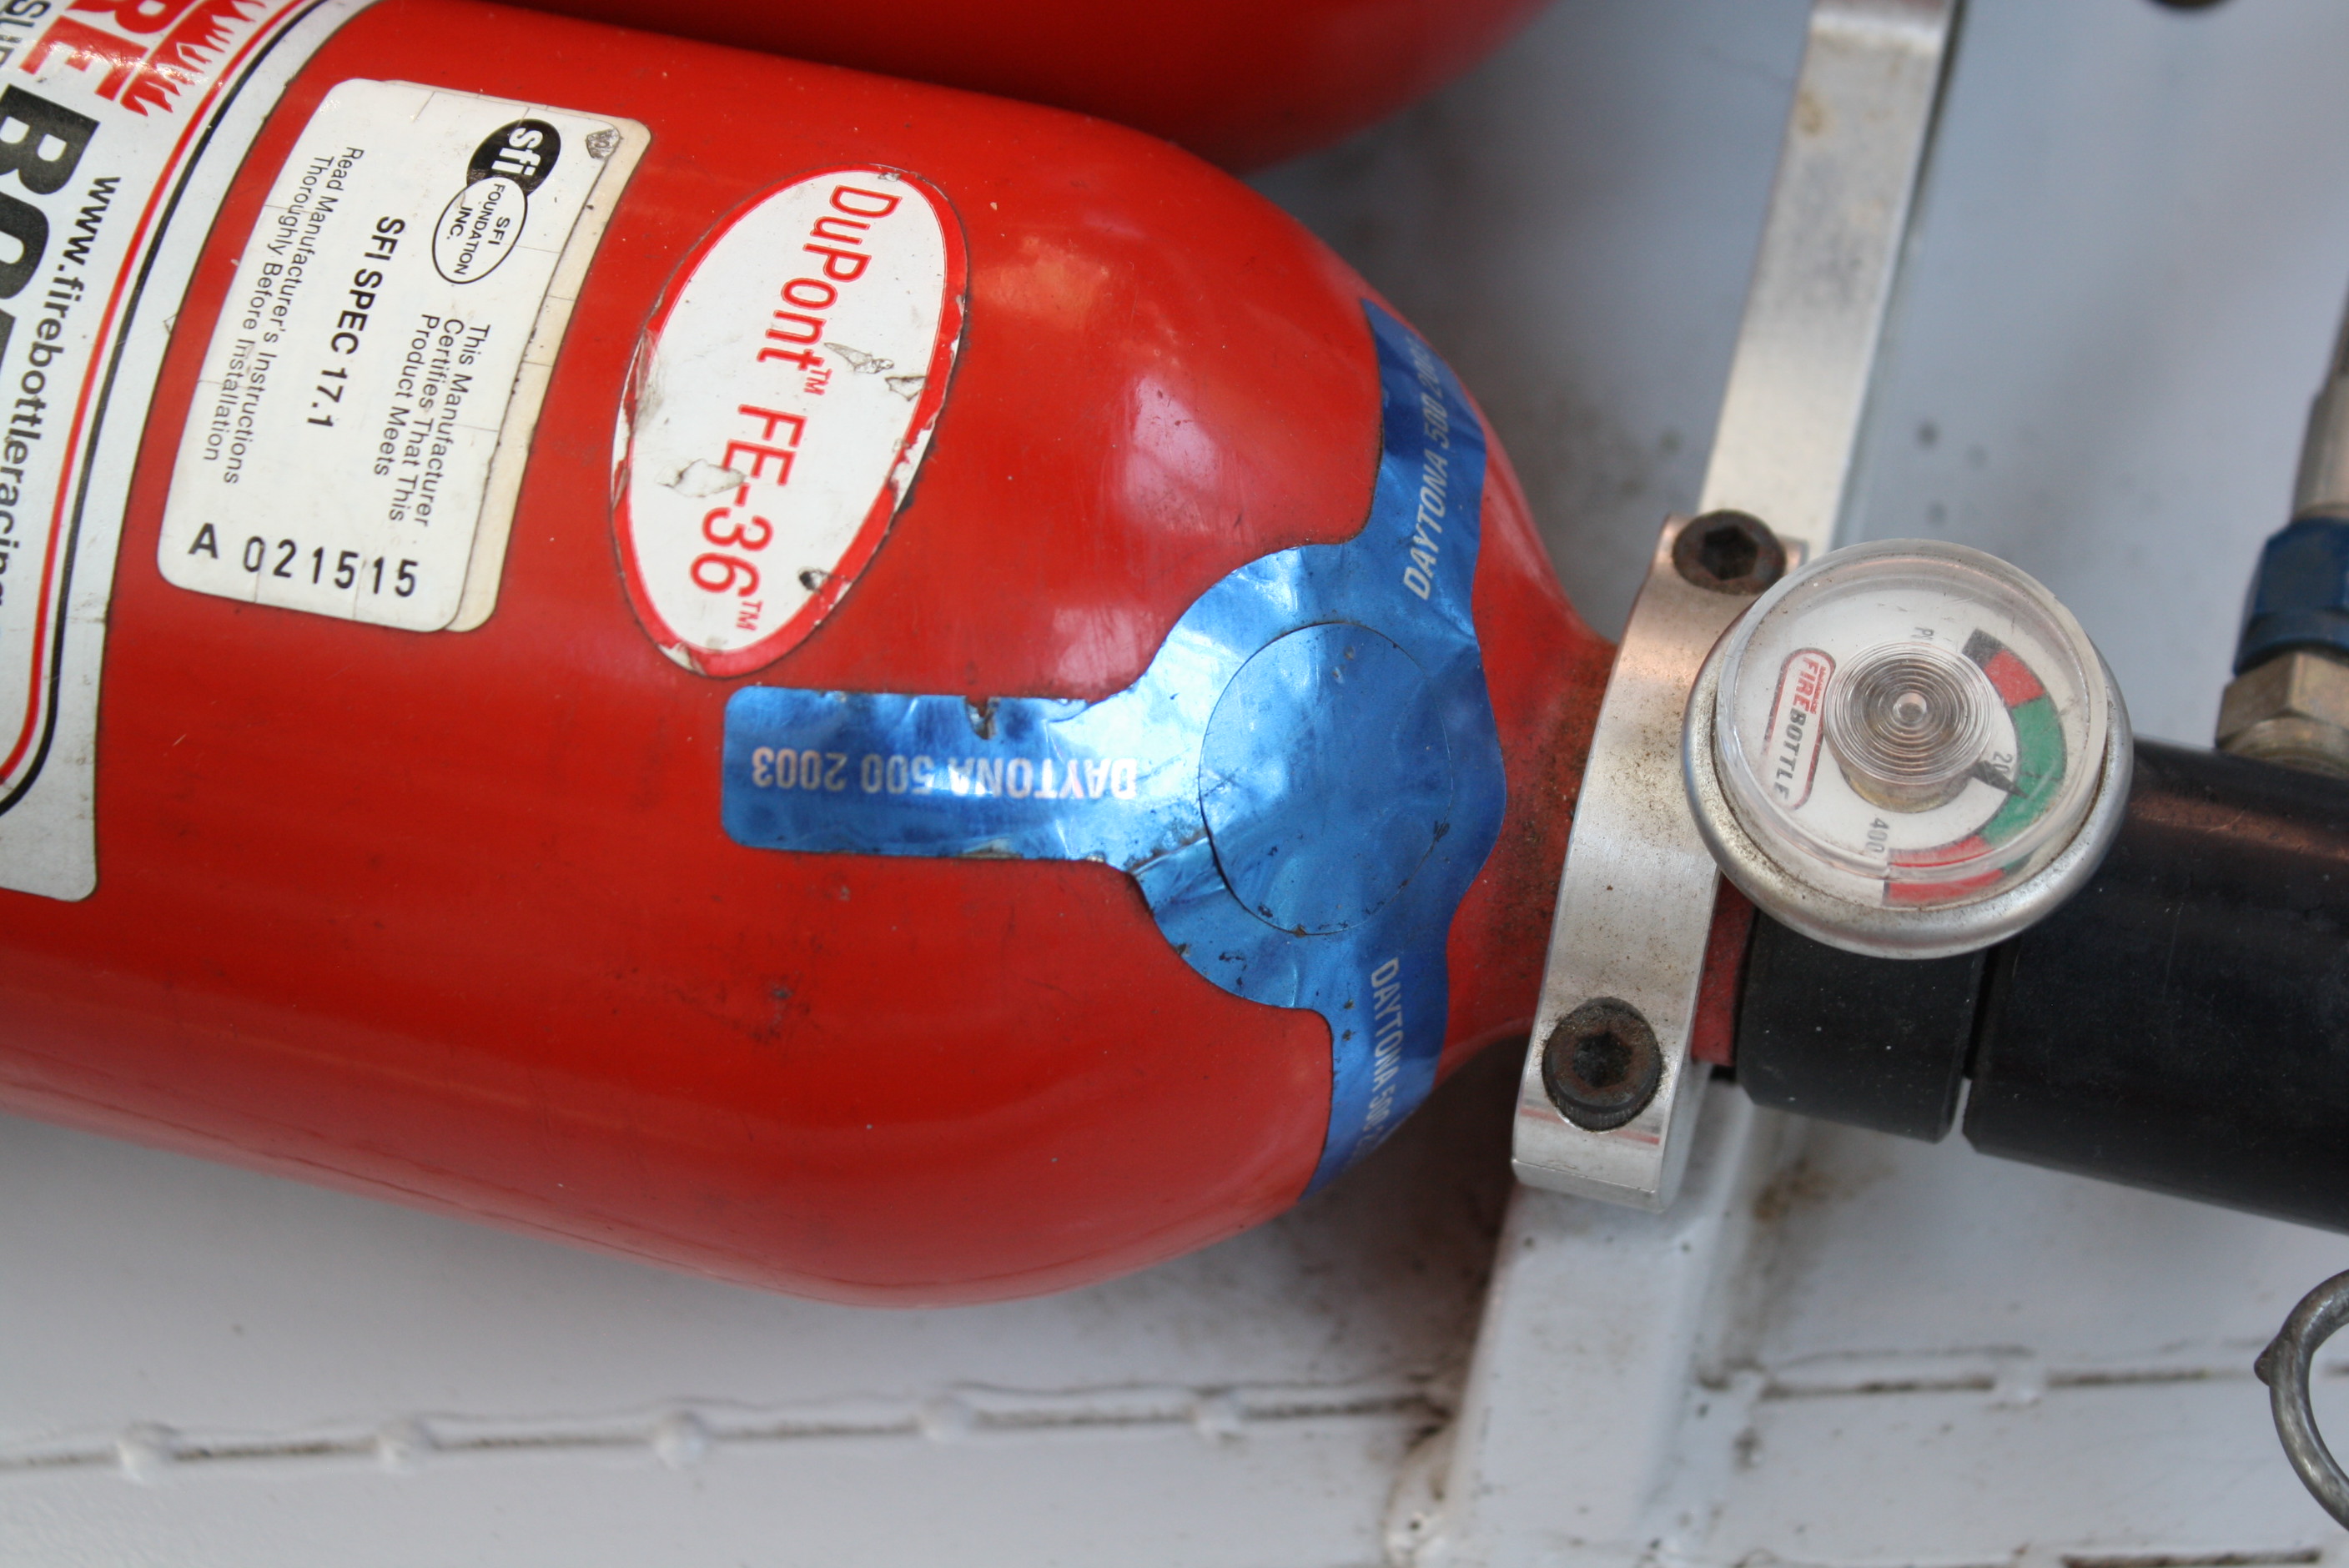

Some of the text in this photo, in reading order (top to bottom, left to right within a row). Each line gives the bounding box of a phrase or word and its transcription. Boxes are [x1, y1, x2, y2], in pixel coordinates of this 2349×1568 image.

[491, 127, 544, 176] sfi
[446, 206, 473, 240] INC.
[454, 183, 506, 275] FOUNDATION
[488, 216, 511, 245] SFI
[203, 156, 334, 460] Thoroughly Before Installation
[224, 146, 365, 484] Read Manufacturer's Instructions
[307, 216, 406, 427] SFI SPEC 17.1
[374, 314, 440, 476] Product Meets
[389, 319, 465, 521] Certifies That This
[415, 324, 490, 527] This Manufacturer
[1421, 391, 1450, 449] 500
[188, 522, 420, 597] A 021515
[1403, 448, 1449, 601] DAYTONA
[752, 746, 1138, 800] DAYTONA 500 2003
[1371, 957, 1405, 1091] DAYTONA
